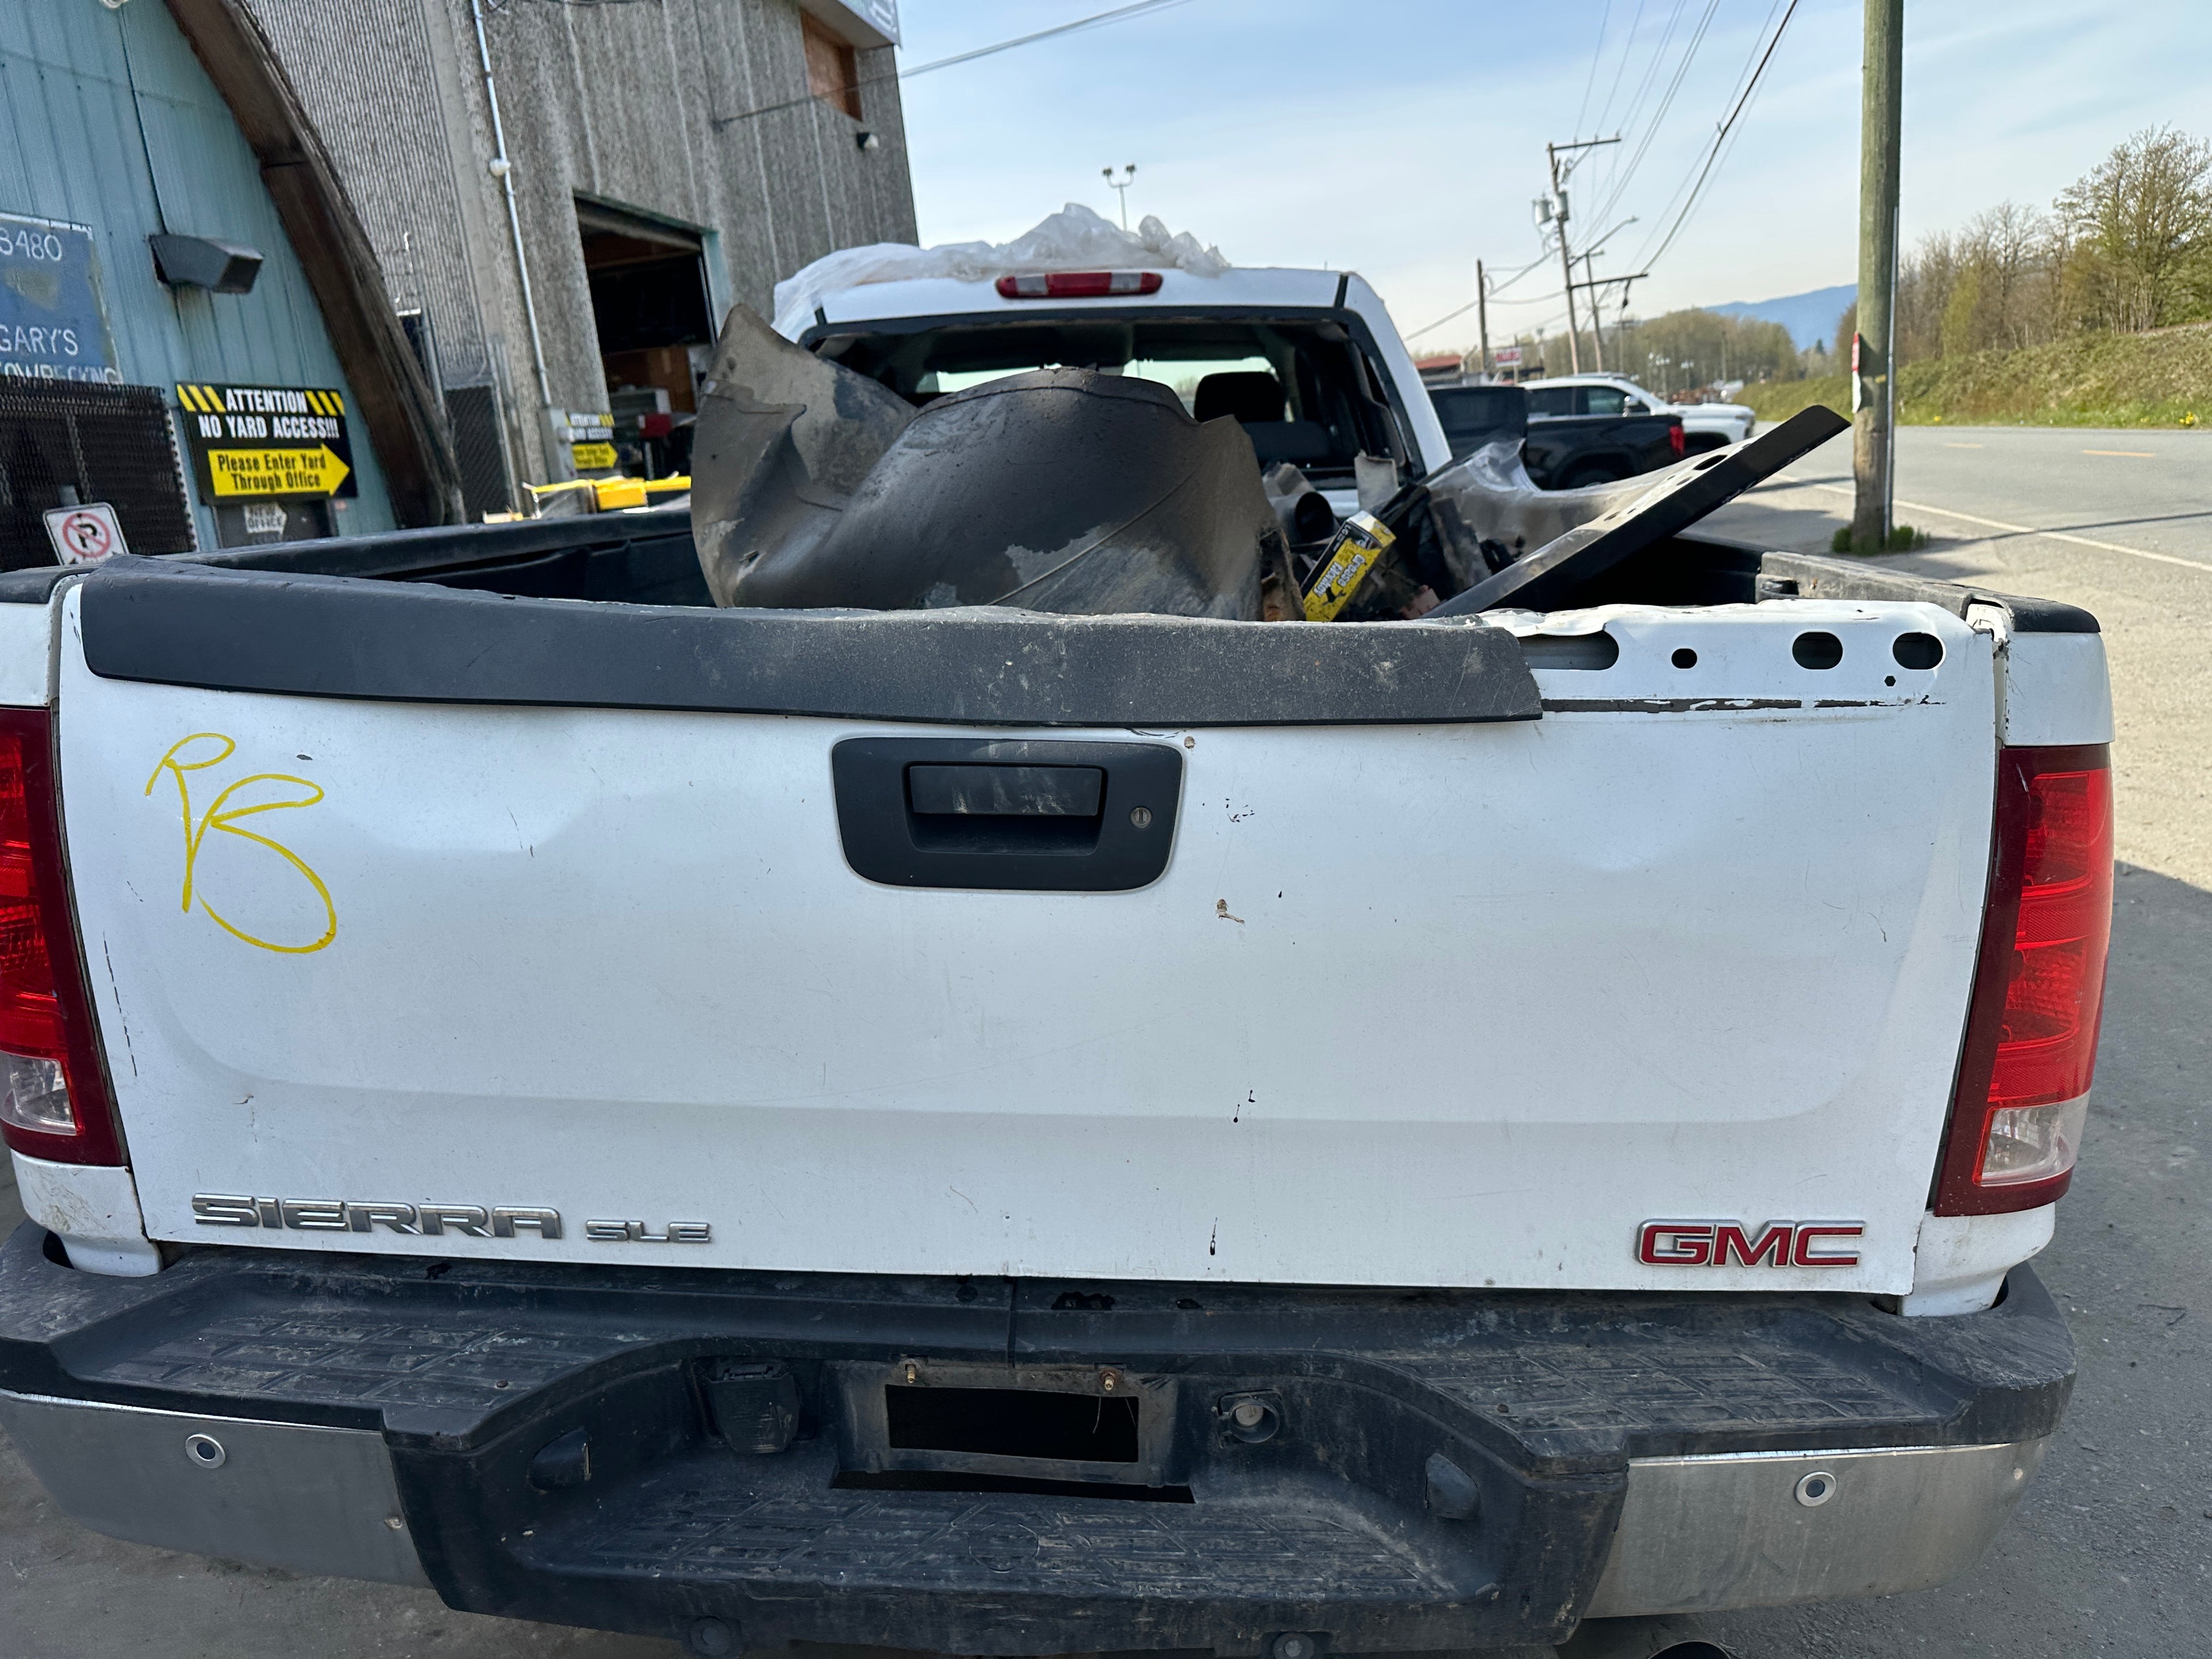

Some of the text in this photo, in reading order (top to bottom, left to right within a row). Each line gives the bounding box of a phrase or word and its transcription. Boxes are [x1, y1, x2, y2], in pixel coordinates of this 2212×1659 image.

[0, 324, 79, 356] GARY'S
[225, 388, 309, 413] ATTENTION
[198, 415, 340, 439] NO YARD ACCESS!!!
[217, 452, 327, 472] Please Enter Yard
[230, 471, 321, 493] Through Office
[1313, 561, 1343, 597] Monkey
[1337, 554, 1366, 587] Grease
[192, 1192, 711, 1244] SIERRA SLE
[1635, 1218, 1866, 1268] GMC
